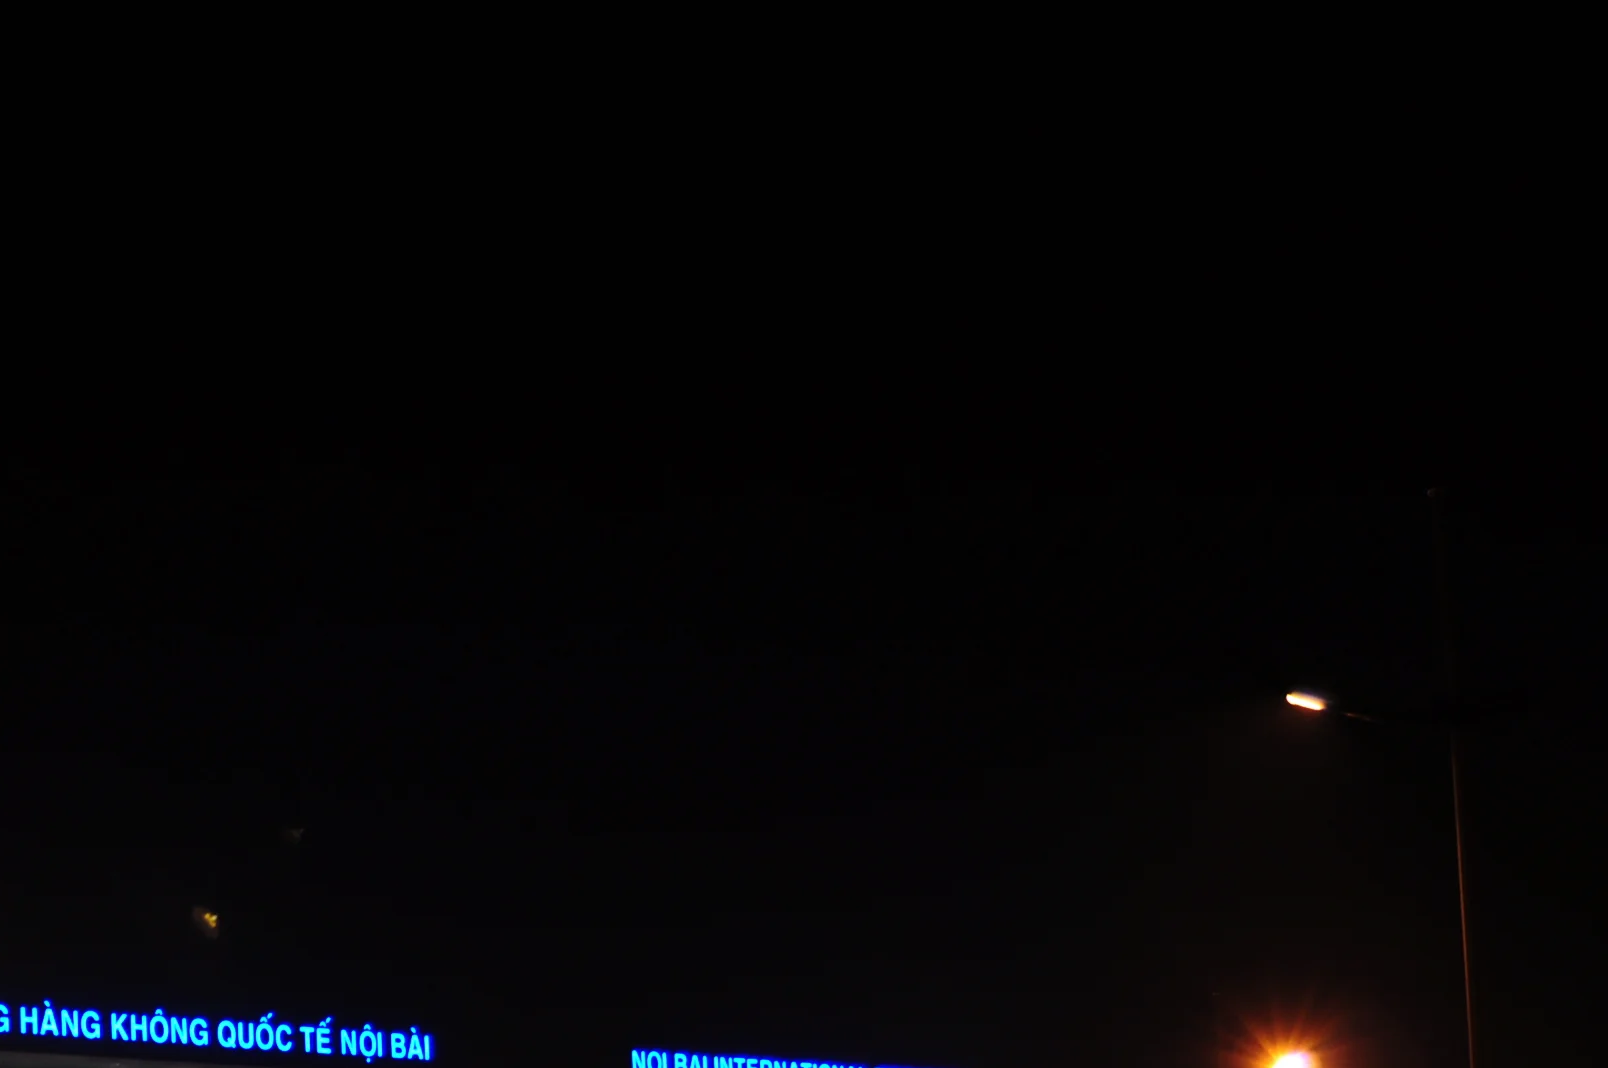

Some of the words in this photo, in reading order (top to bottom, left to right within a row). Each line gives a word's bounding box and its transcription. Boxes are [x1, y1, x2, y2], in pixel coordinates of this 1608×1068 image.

[19, 1000, 102, 1040] HÀNG
[110, 1008, 210, 1047] KHÔNG
[218, 1012, 294, 1052] QUỐC
[299, 1016, 334, 1056] TẾ
[340, 1023, 384, 1063] NỘI
[391, 1025, 432, 1061] BÀI
